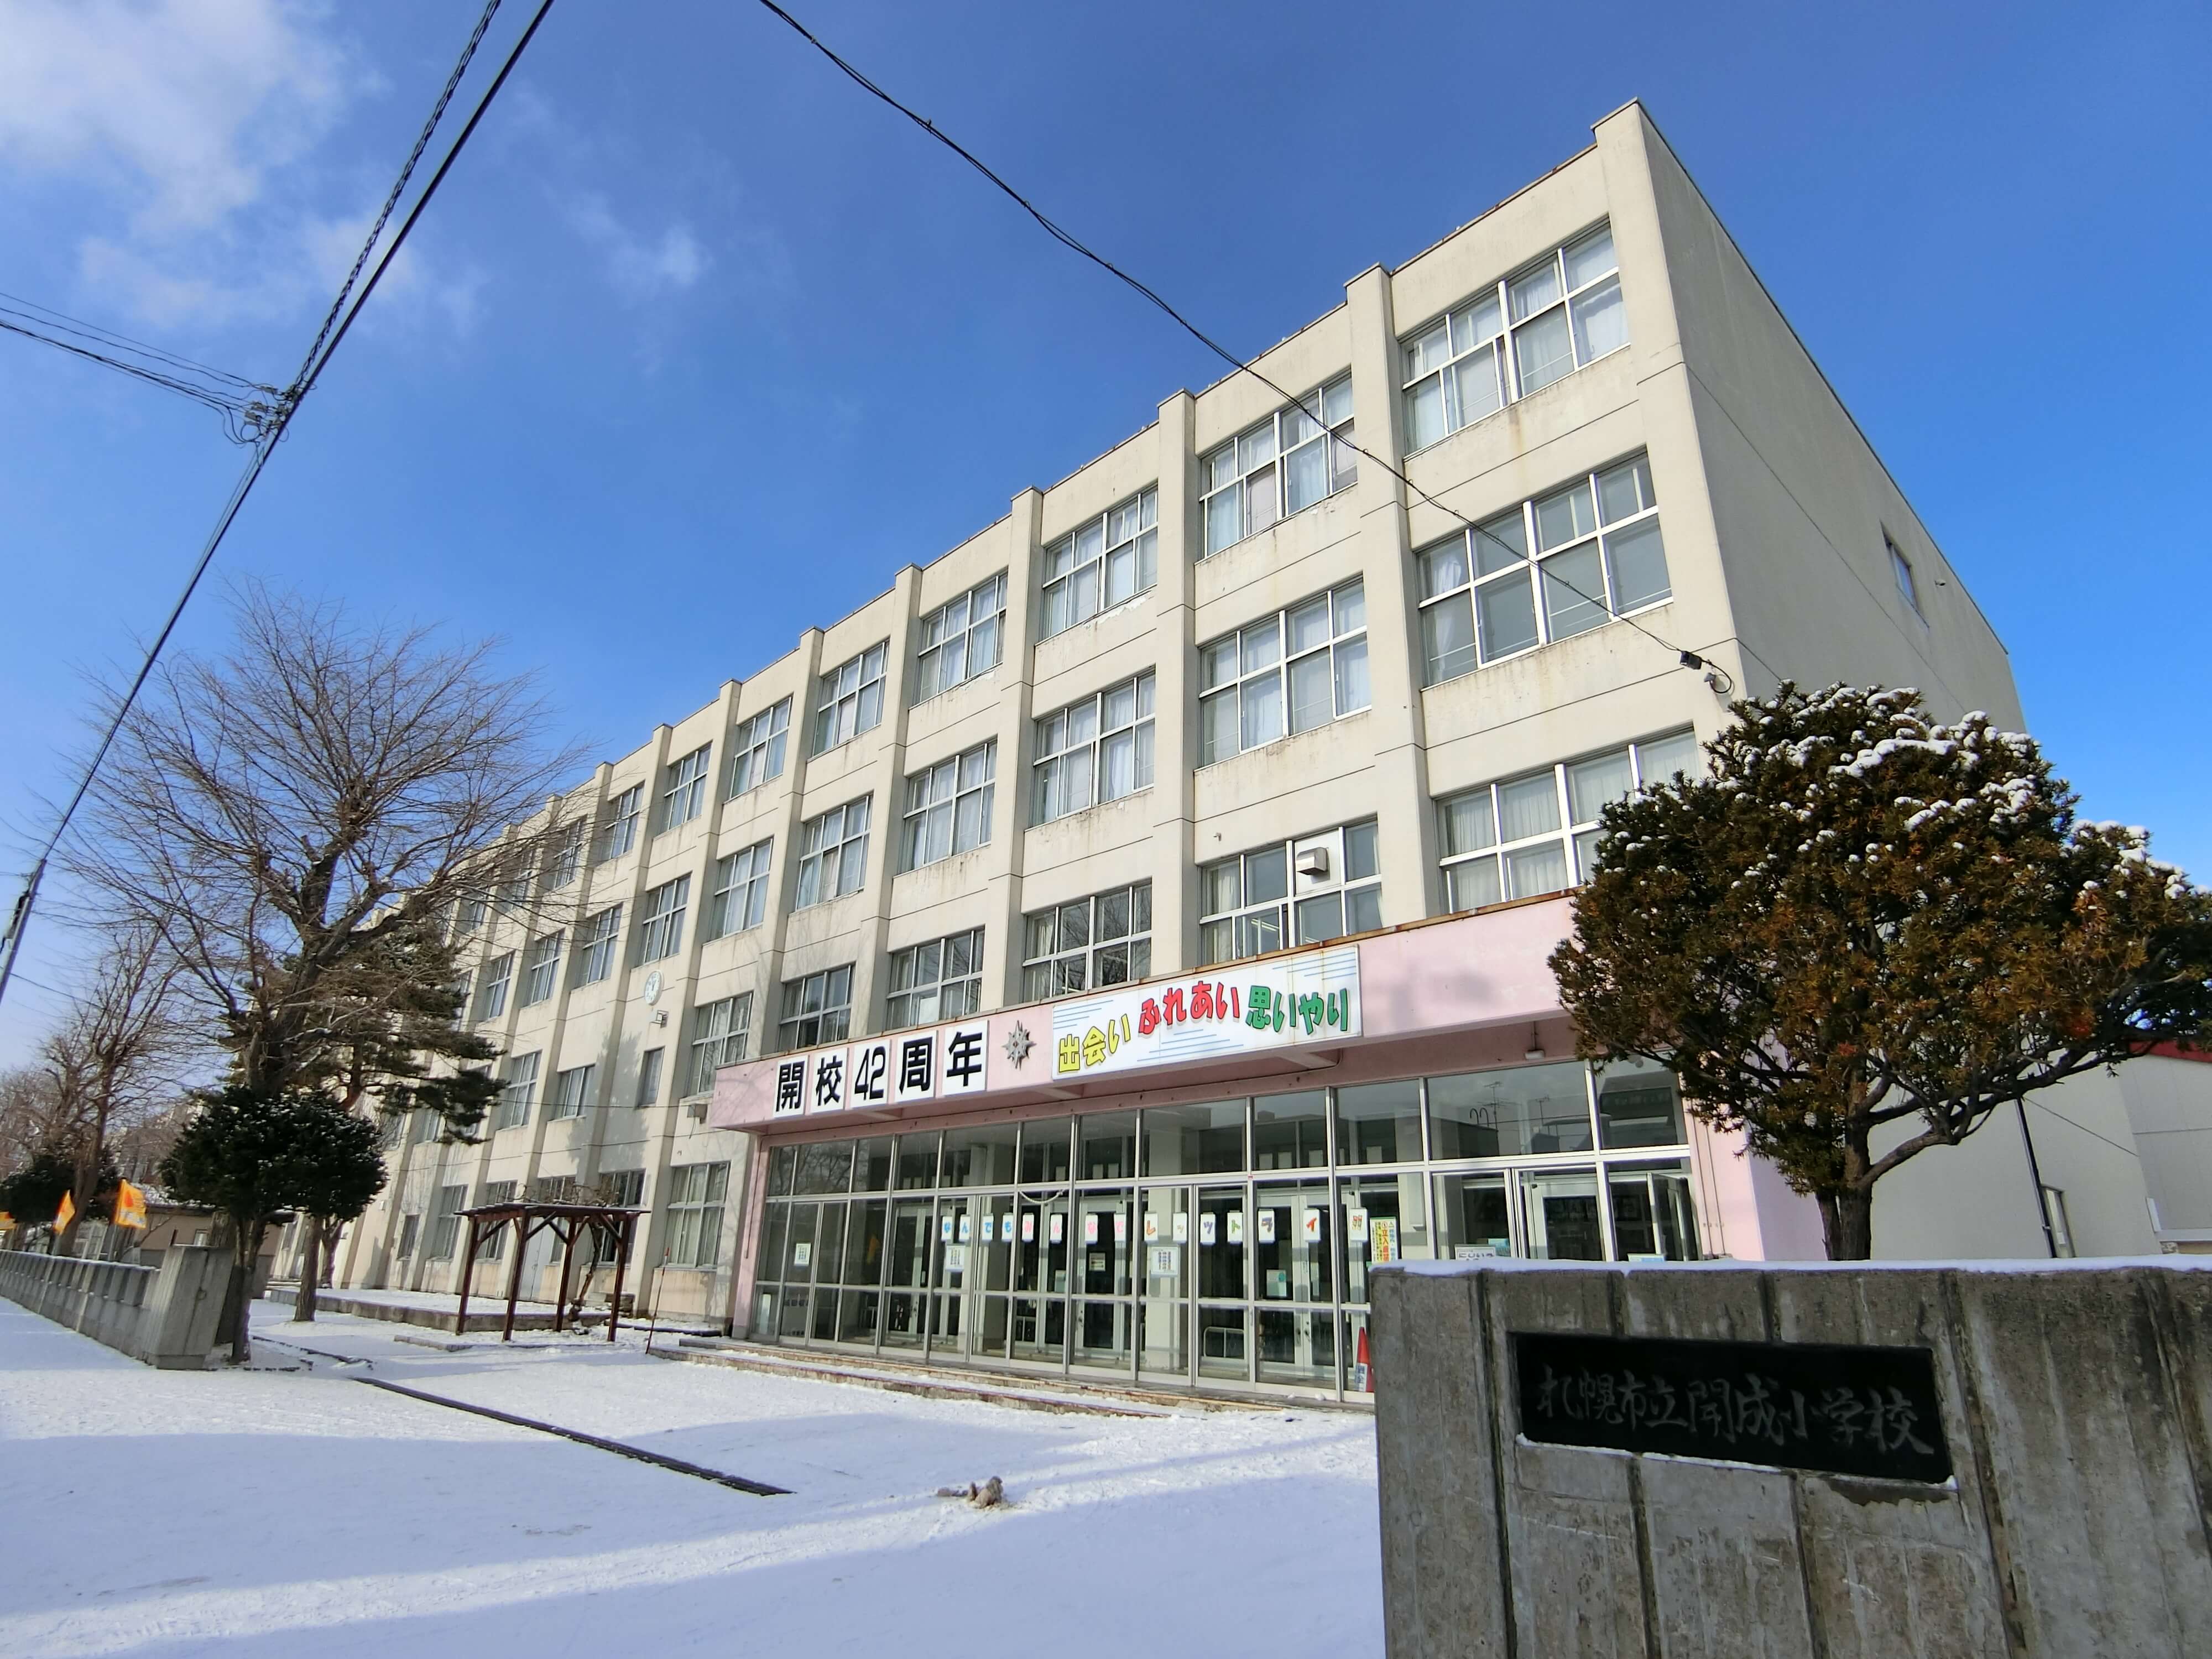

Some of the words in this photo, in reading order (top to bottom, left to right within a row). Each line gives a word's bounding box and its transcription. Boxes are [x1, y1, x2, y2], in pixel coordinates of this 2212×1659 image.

[776, 1031, 983, 1112] 開校42周年
[1058, 1013, 1131, 1073] 出会い
[1138, 980, 1240, 1035] ふれあい
[1245, 985, 1348, 1035] 思いやり
[1536, 1362, 1935, 1455] 札幌市立開成小学校
